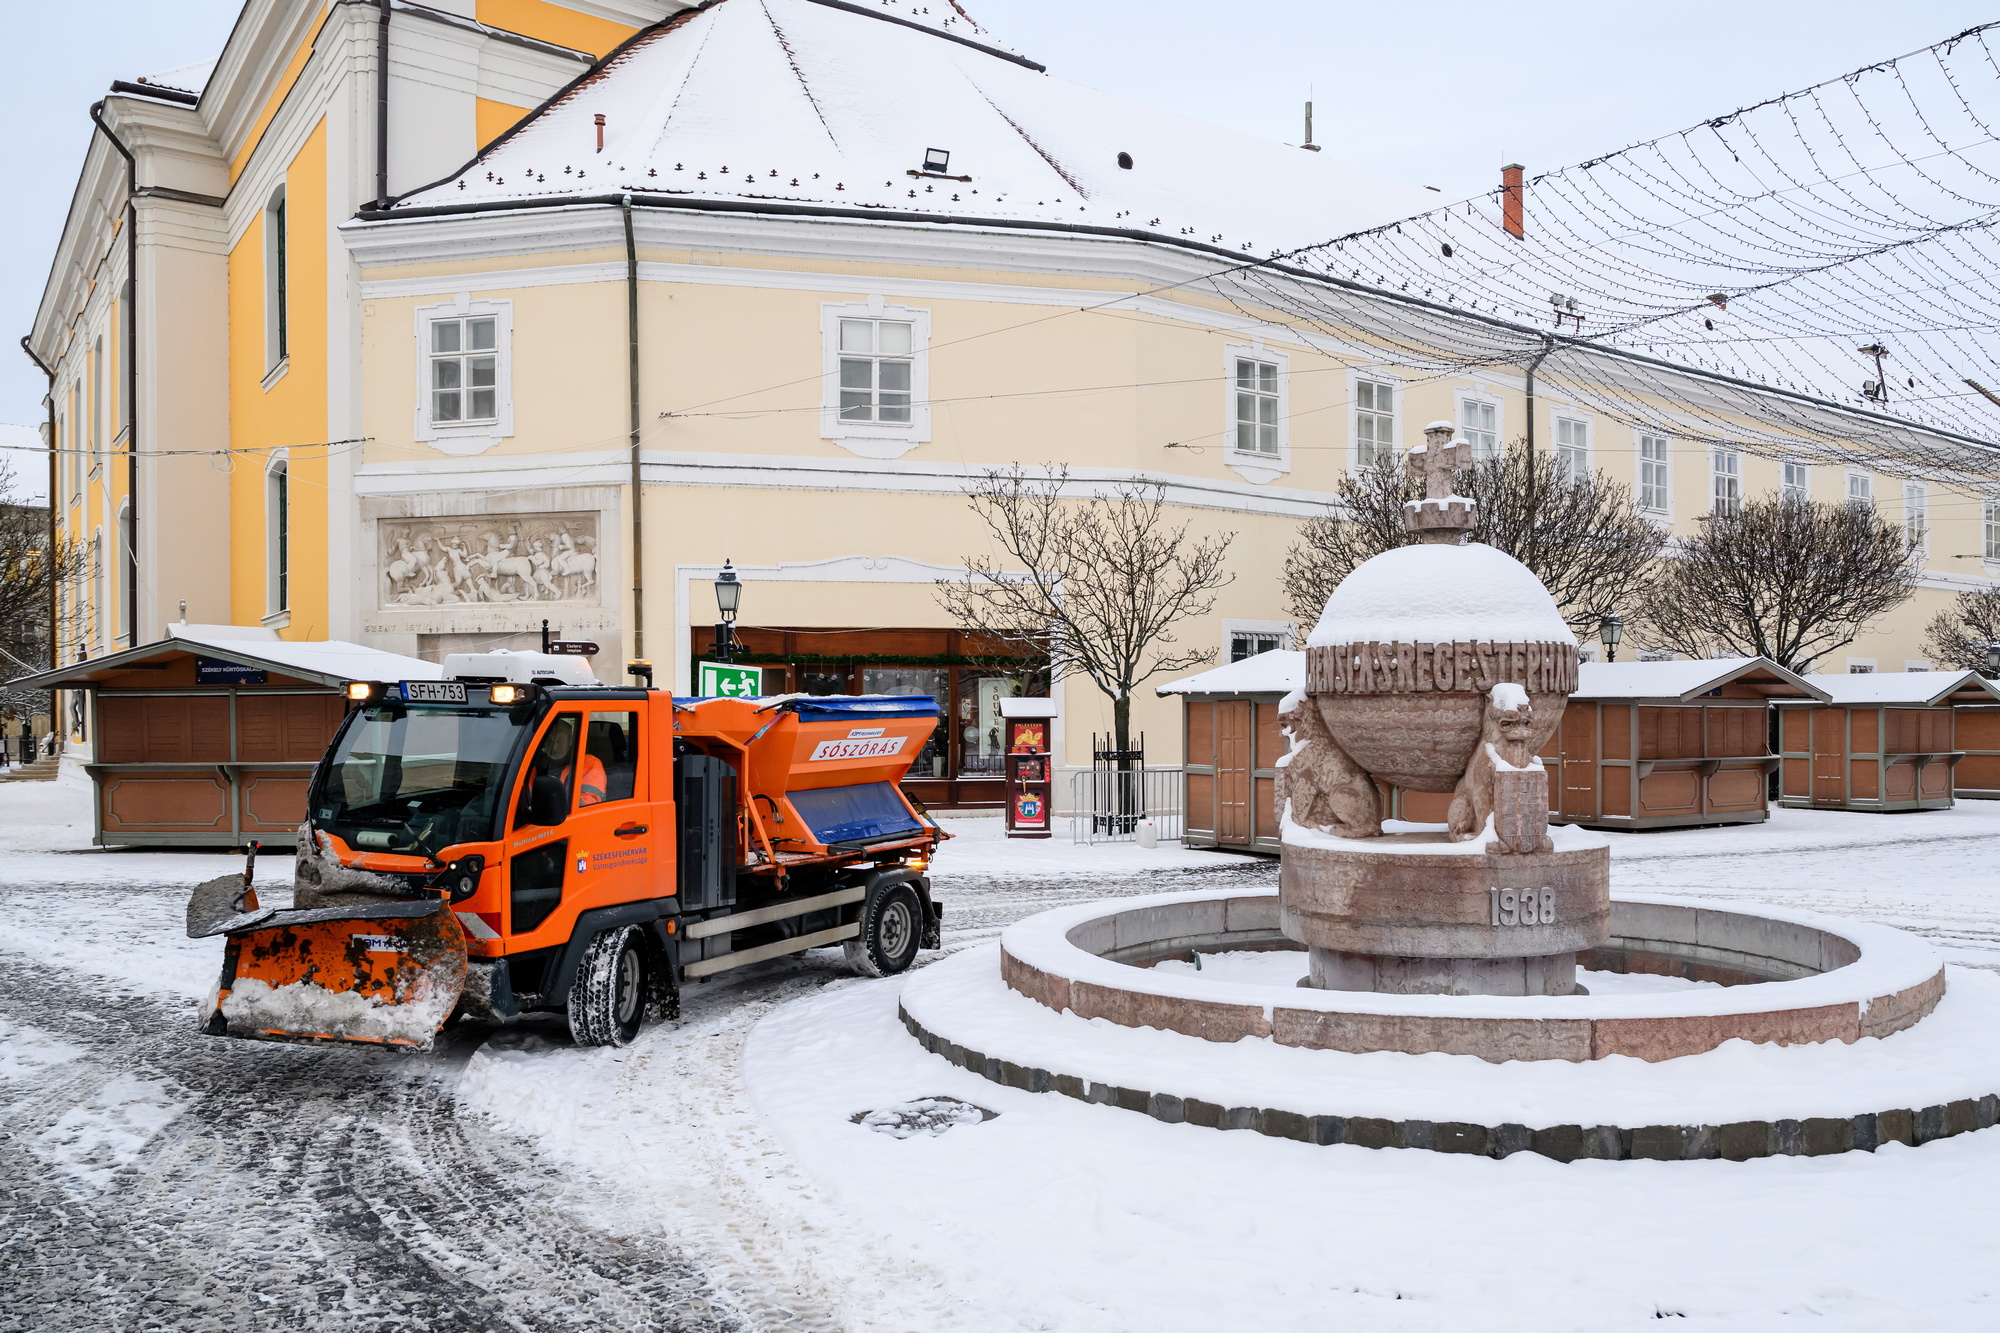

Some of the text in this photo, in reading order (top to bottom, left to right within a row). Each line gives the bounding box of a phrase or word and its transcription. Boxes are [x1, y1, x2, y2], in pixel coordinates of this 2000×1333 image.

[364, 624, 397, 633] SZENT
[1398, 641, 1472, 692] REGE
[410, 684, 464, 700] SFH-753
[818, 739, 898, 759] SÓSZÓRÁS
[513, 836, 537, 847] Multicar
[592, 846, 648, 861] SZÉKESFEHÉRVÁR
[592, 857, 648, 871] Városgondnoksága
[1490, 886, 1556, 926] 1938
